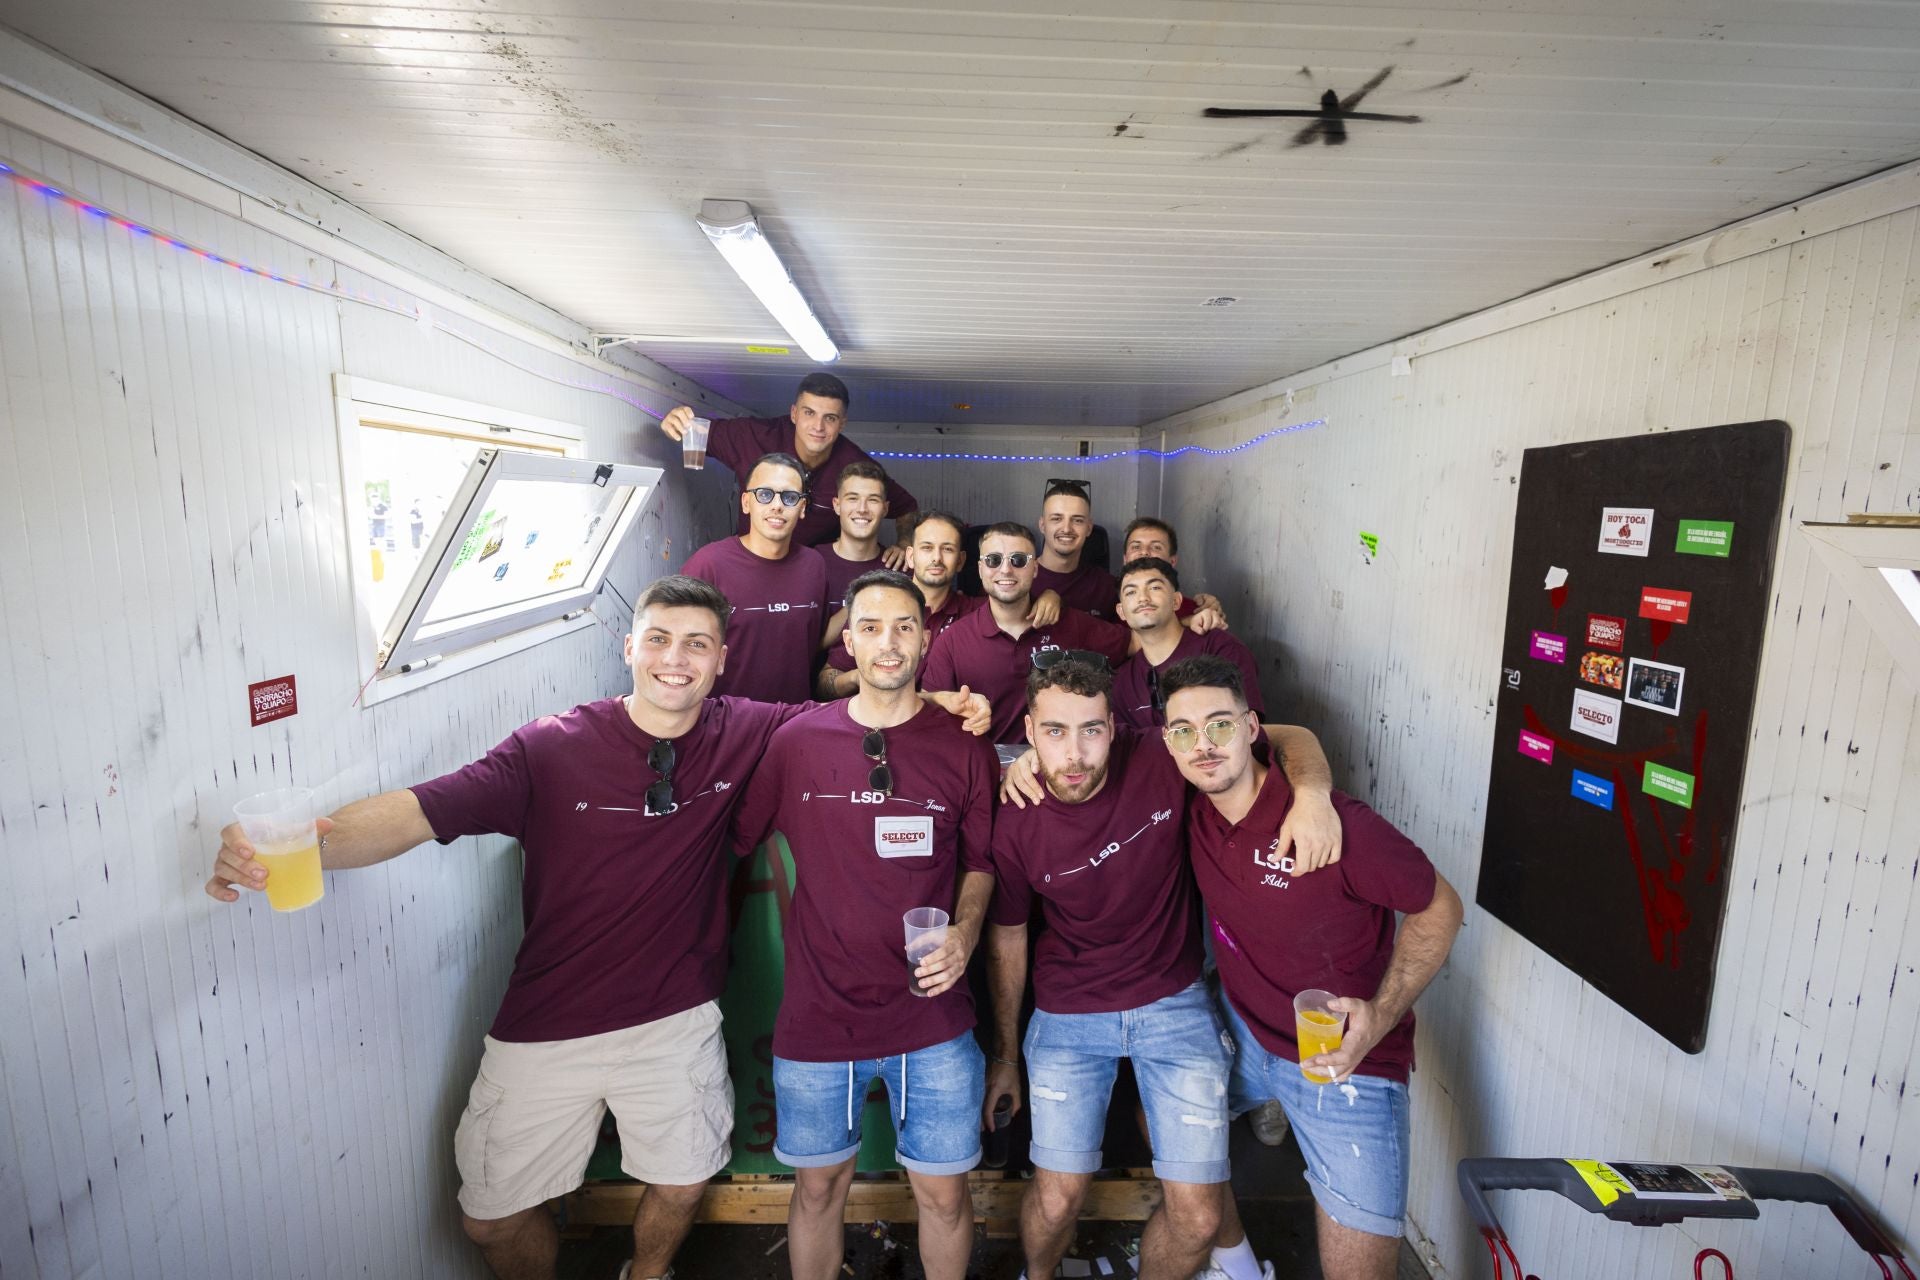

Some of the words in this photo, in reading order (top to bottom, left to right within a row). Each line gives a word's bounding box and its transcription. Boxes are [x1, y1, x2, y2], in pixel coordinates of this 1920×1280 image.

[1607, 515, 1624, 523] HOY
[1625, 515, 1646, 524] TOCA
[768, 603, 790, 613] LSD
[1589, 624, 1622, 636] BORRACHO
[1594, 631, 1615, 640] GUAPO
[1040, 635, 1051, 644] 29
[254, 688, 293, 705] BORRACHO
[261, 698, 286, 710] GUAPO
[1577, 706, 1613, 724] SELECTO
[851, 791, 885, 804] LSD
[574, 801, 589, 812] 19
[881, 831, 926, 842] SELECTO
[1089, 841, 1121, 867] LSD
[1151, 808, 1172, 825] Hugo
[1254, 848, 1296, 873] LSD
[1260, 874, 1289, 890] Adri
